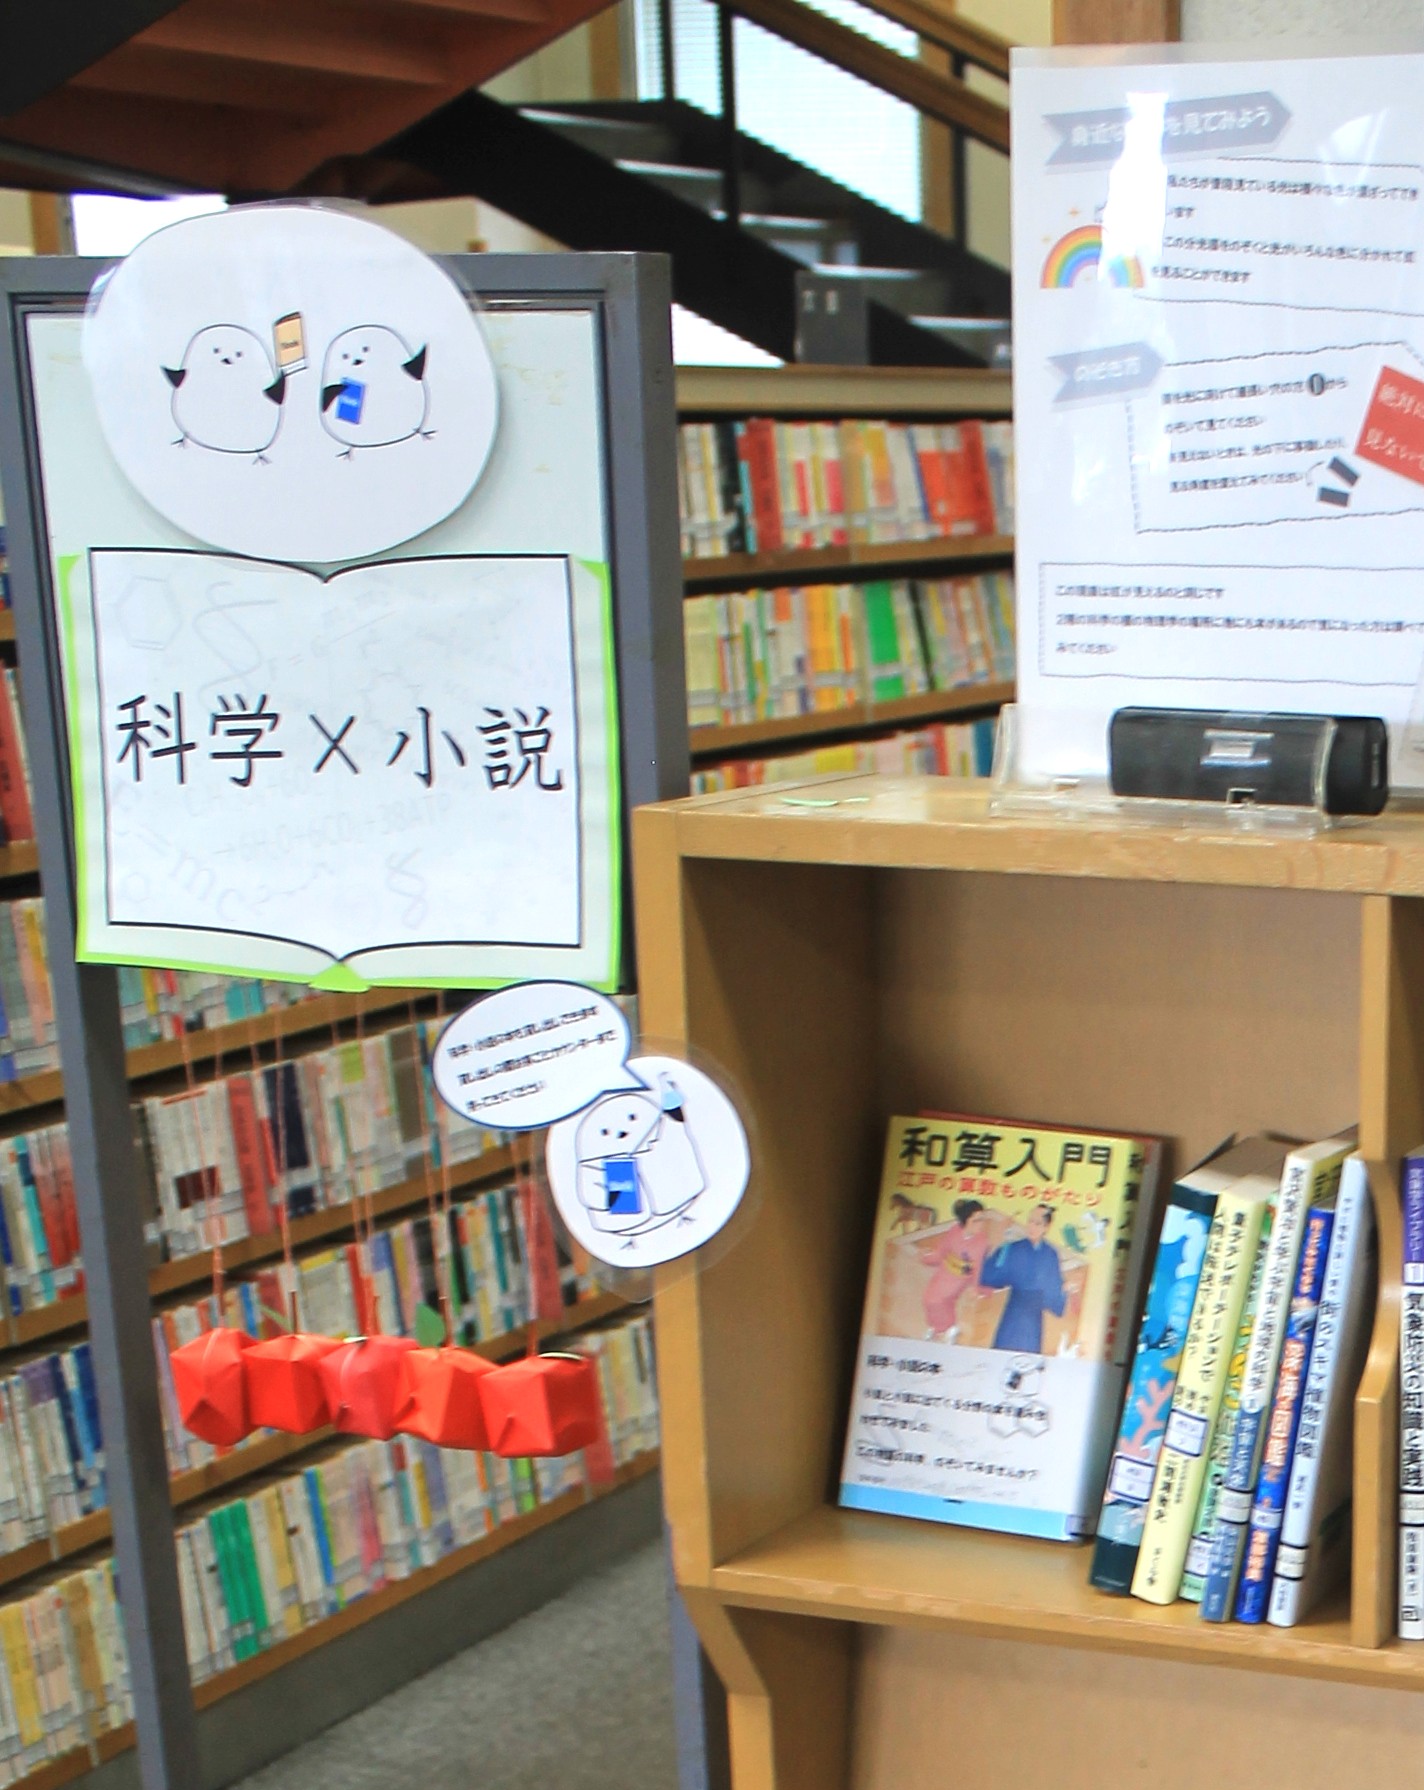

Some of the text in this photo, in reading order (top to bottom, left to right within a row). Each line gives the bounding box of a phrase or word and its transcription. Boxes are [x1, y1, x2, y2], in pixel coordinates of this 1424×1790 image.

[115, 690, 566, 792] 科学×小説
[899, 1126, 1114, 1188] 和算入門
[896, 1169, 1104, 1210] 江戸の算数ものがたり
